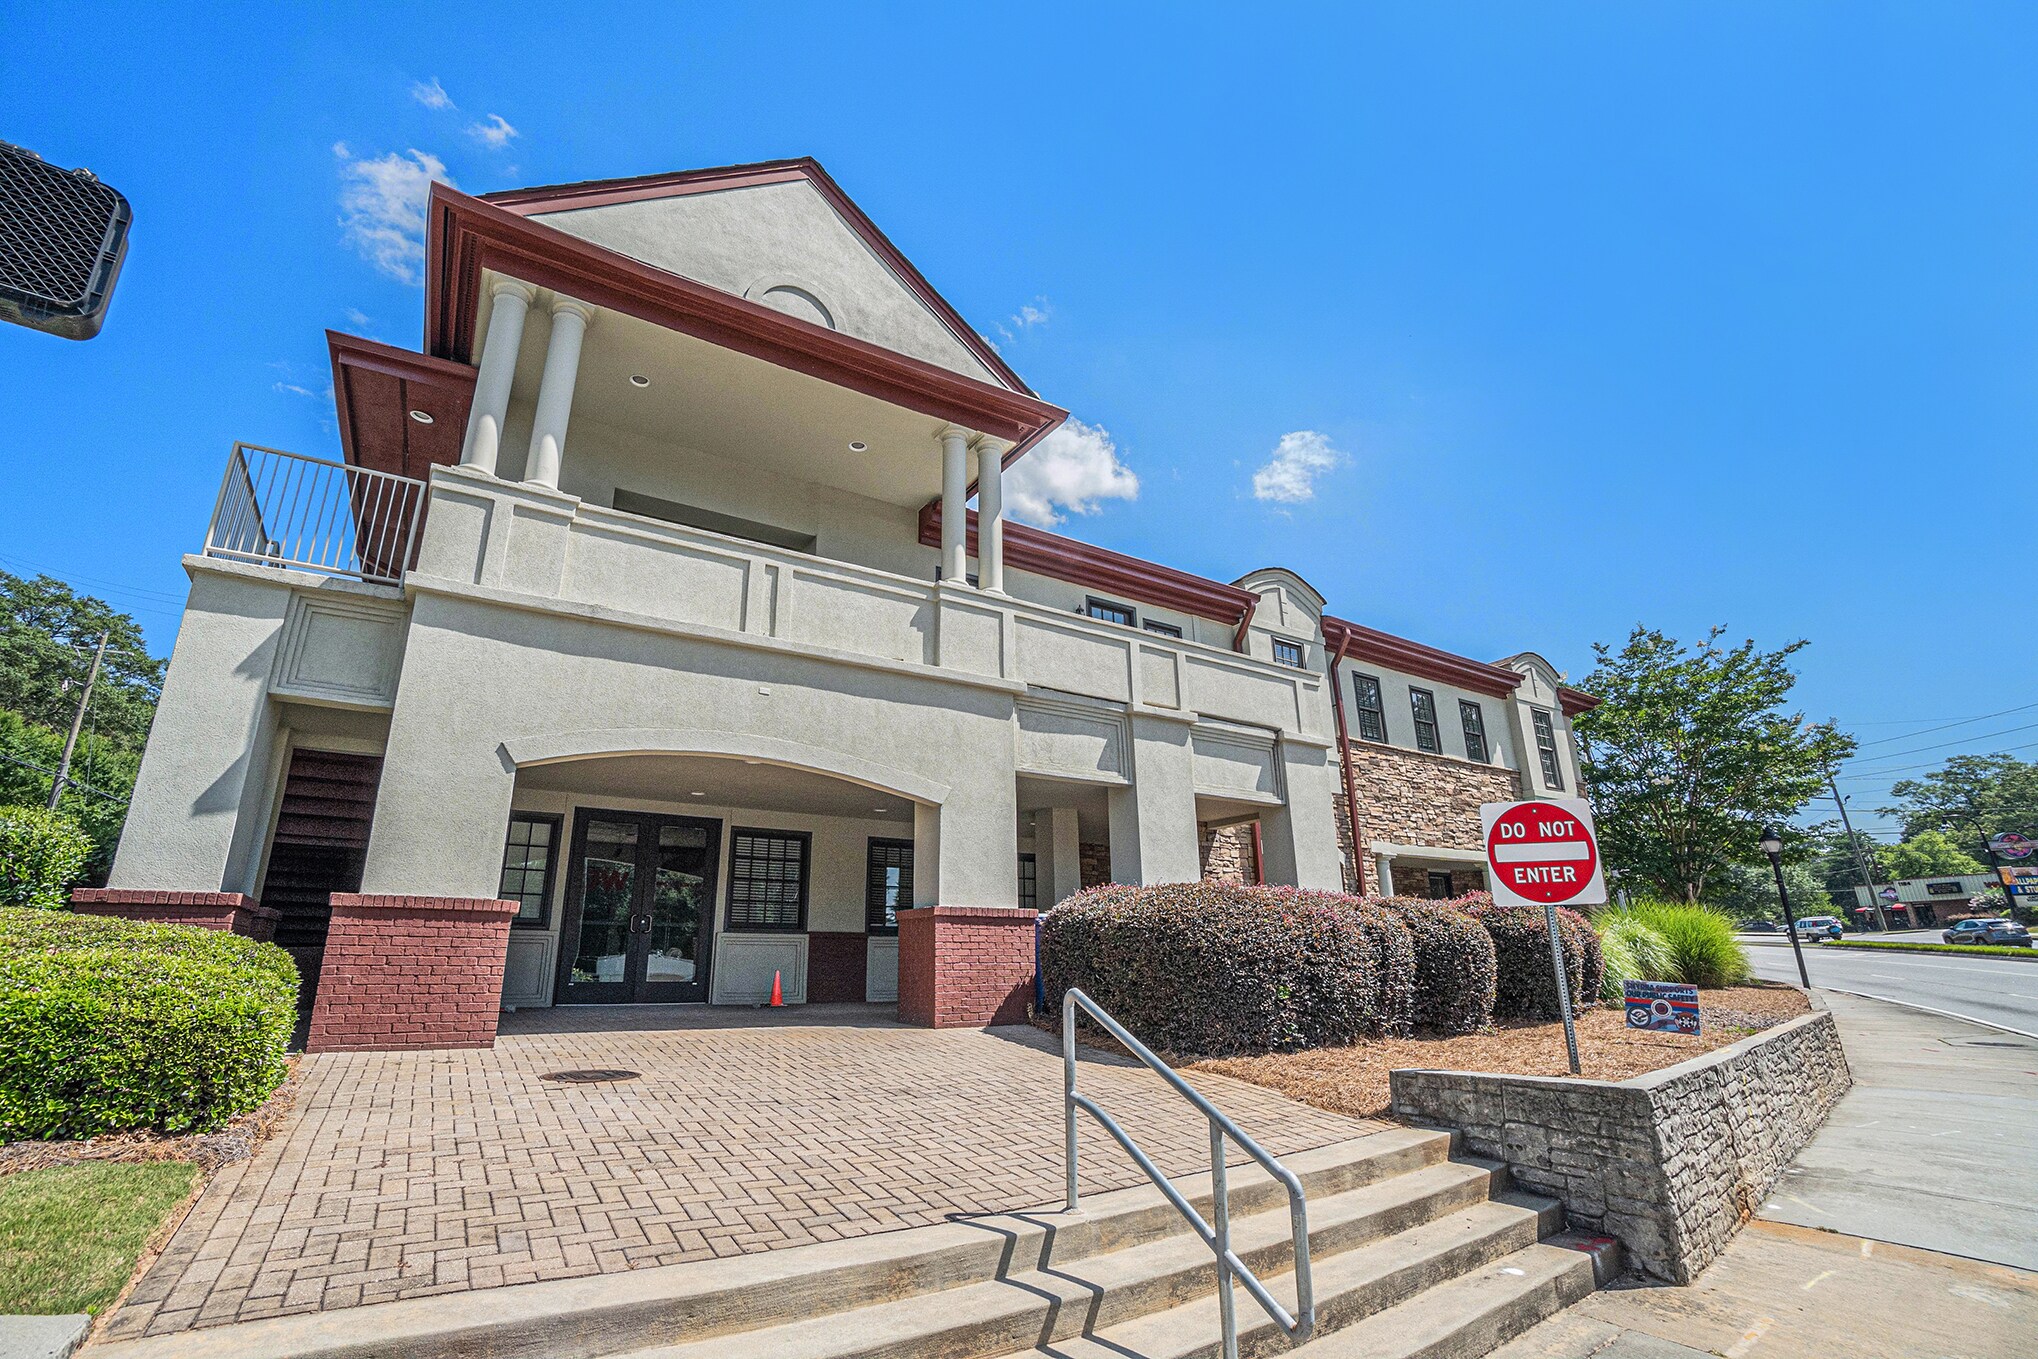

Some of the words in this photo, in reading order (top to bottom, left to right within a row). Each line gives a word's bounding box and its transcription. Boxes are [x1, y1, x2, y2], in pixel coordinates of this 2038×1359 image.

[1500, 822, 1526, 838] DO
[1538, 820, 1575, 837] NOT
[1514, 866, 1577, 884] ENTER
[1626, 989, 1642, 998] OUR
[1642, 990, 1667, 1000] PUBLIC
[1668, 993, 1695, 1002] SAFETY
[1656, 985, 1694, 995] SUPPORTS
